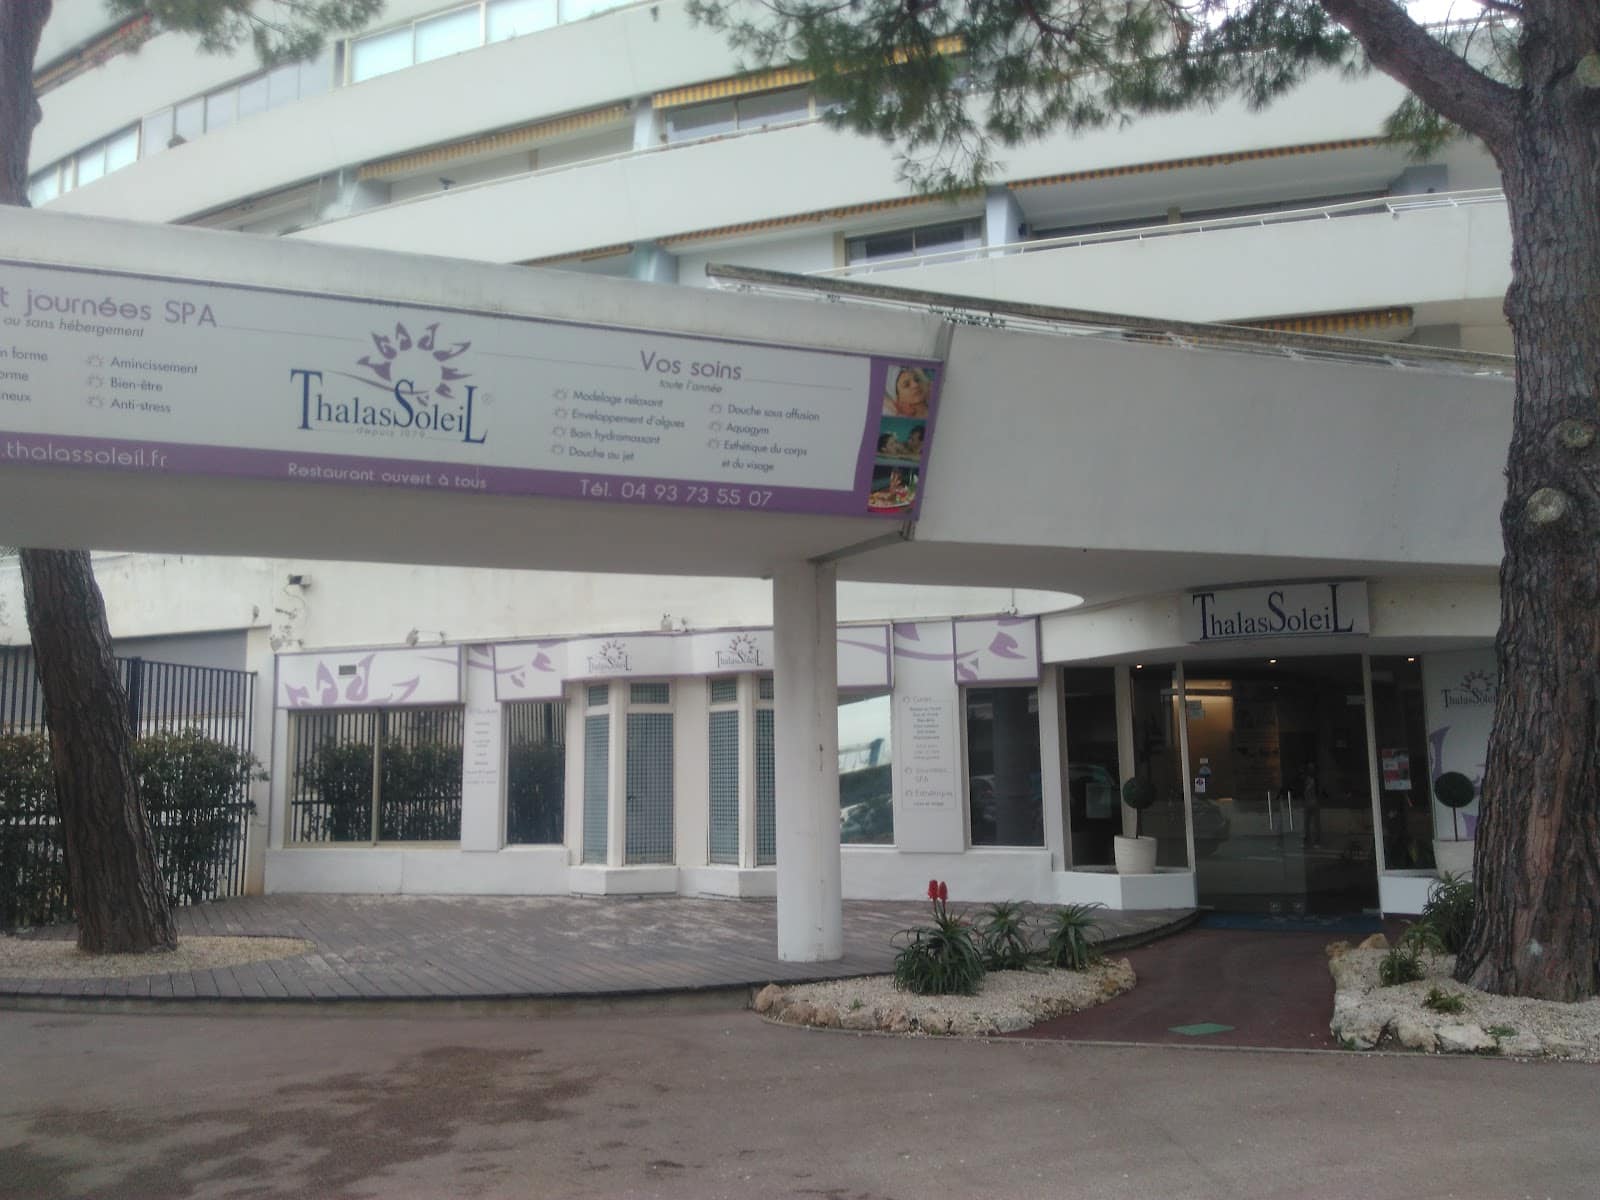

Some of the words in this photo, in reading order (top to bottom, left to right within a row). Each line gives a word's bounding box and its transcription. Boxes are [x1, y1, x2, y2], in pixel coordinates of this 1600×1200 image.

[24, 288, 152, 321] journées
[164, 299, 217, 328] SPA
[25, 319, 54, 329] sans
[59, 318, 144, 337] hébergement
[12, 345, 48, 361] forme
[110, 356, 198, 374] Amincissement
[640, 349, 681, 375] Vos
[690, 360, 742, 381] soins
[111, 376, 164, 391] Bien-être
[659, 379, 684, 391] toute
[686, 379, 724, 393] l'année
[110, 398, 172, 413] Anti-stress
[572, 390, 622, 406] Modelage
[624, 394, 664, 407] relaxant
[571, 408, 644, 425] Enveloppement
[646, 414, 685, 430] d'algues
[728, 403, 762, 416] Douche
[764, 409, 783, 418] sous
[785, 407, 820, 422] affusion
[570, 427, 592, 440] Bain
[726, 423, 769, 437] Aquagym
[568, 446, 605, 459] Douche
[607, 450, 620, 460] au
[622, 450, 635, 462] jet
[723, 439, 768, 454] Esthétique
[770, 443, 782, 454] du
[783, 447, 808, 457] corps
[732, 459, 744, 469] du
[746, 461, 775, 473] visage
[287, 462, 375, 481] Restaurant
[381, 471, 431, 484] ouvert
[438, 474, 449, 486] à
[455, 475, 487, 489] tous
[579, 479, 613, 498] Tél.
[621, 481, 646, 500] 04
[655, 484, 678, 502] 93
[686, 486, 709, 504] 73
[717, 488, 741, 505] 55
[748, 490, 772, 508] 07
